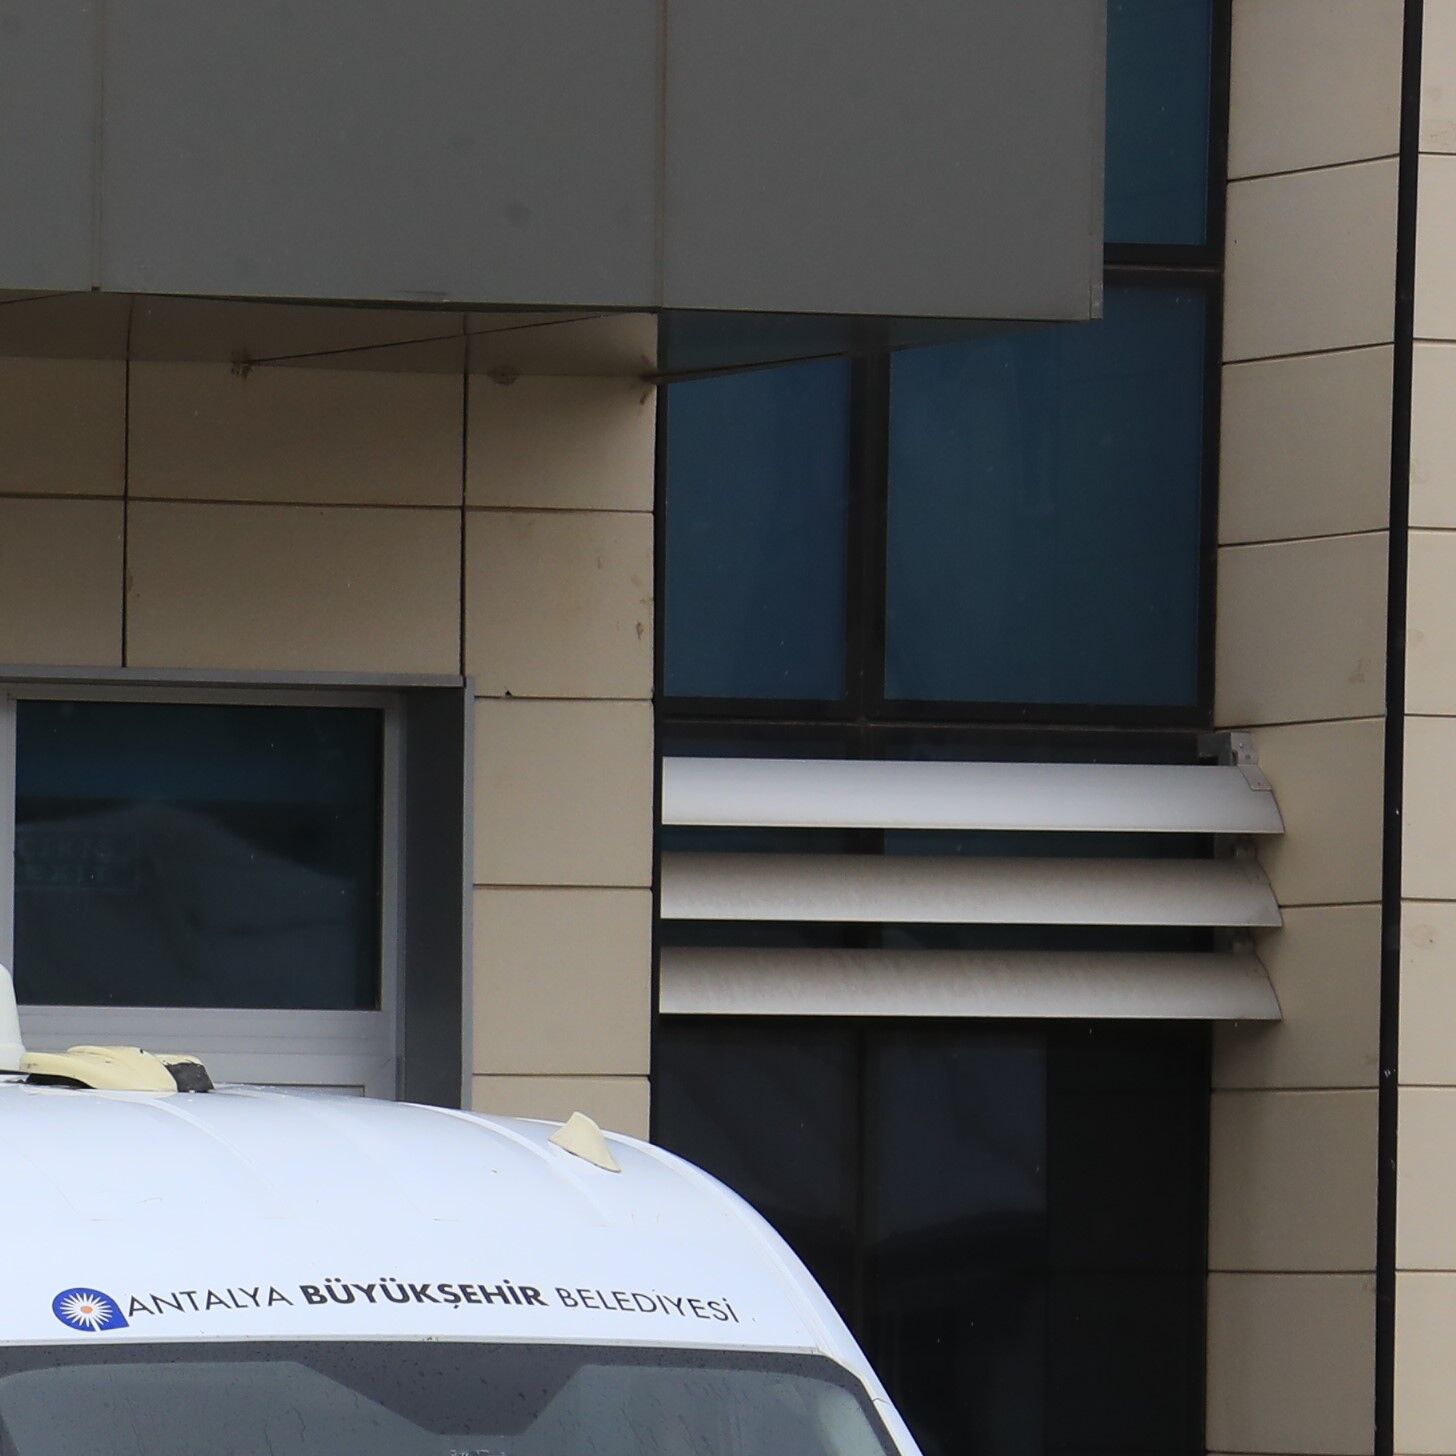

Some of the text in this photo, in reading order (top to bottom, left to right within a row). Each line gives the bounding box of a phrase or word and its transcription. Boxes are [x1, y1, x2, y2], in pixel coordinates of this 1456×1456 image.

[129, 1277, 739, 1323] ANTALYA BÜYÜKŞEHİR BELEDİYESİ
